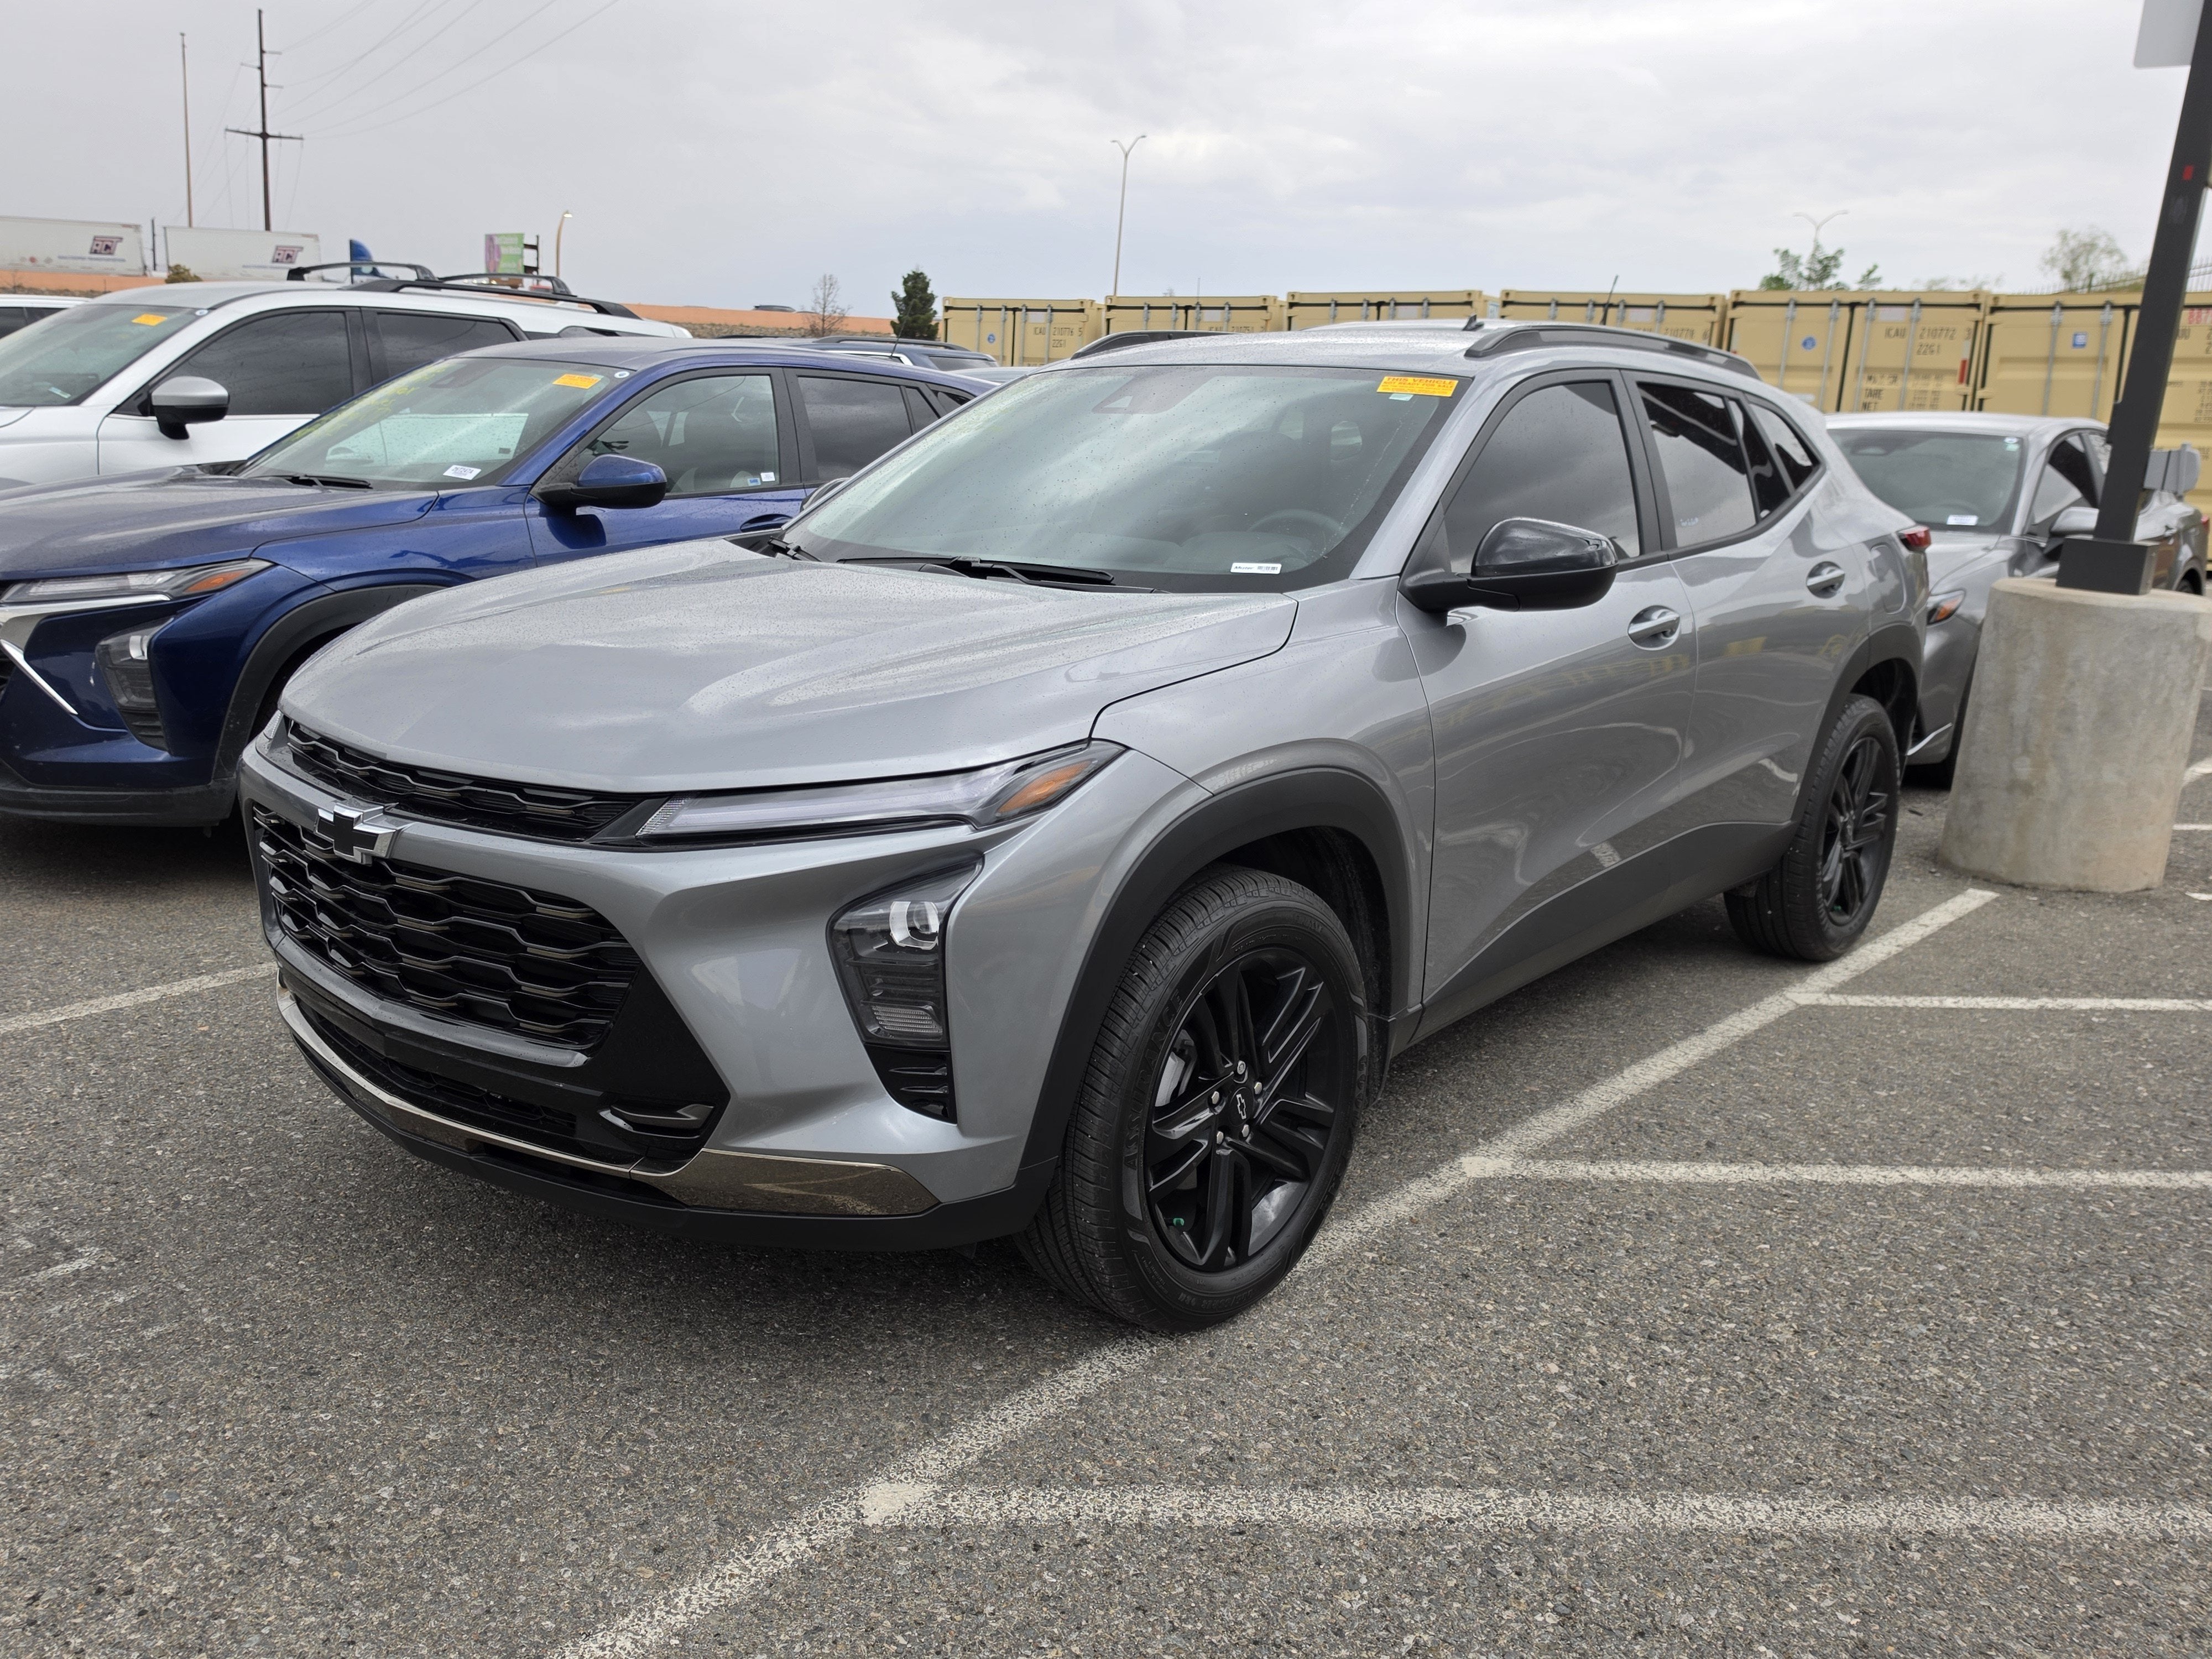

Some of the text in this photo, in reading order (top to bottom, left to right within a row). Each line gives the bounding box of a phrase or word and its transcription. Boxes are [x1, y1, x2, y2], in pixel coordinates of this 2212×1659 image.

[1885, 327, 1907, 338] ICAU
[1919, 327, 1957, 340] 210772
[1865, 389, 1884, 400] TARE
[1861, 401, 1880, 411] NET
